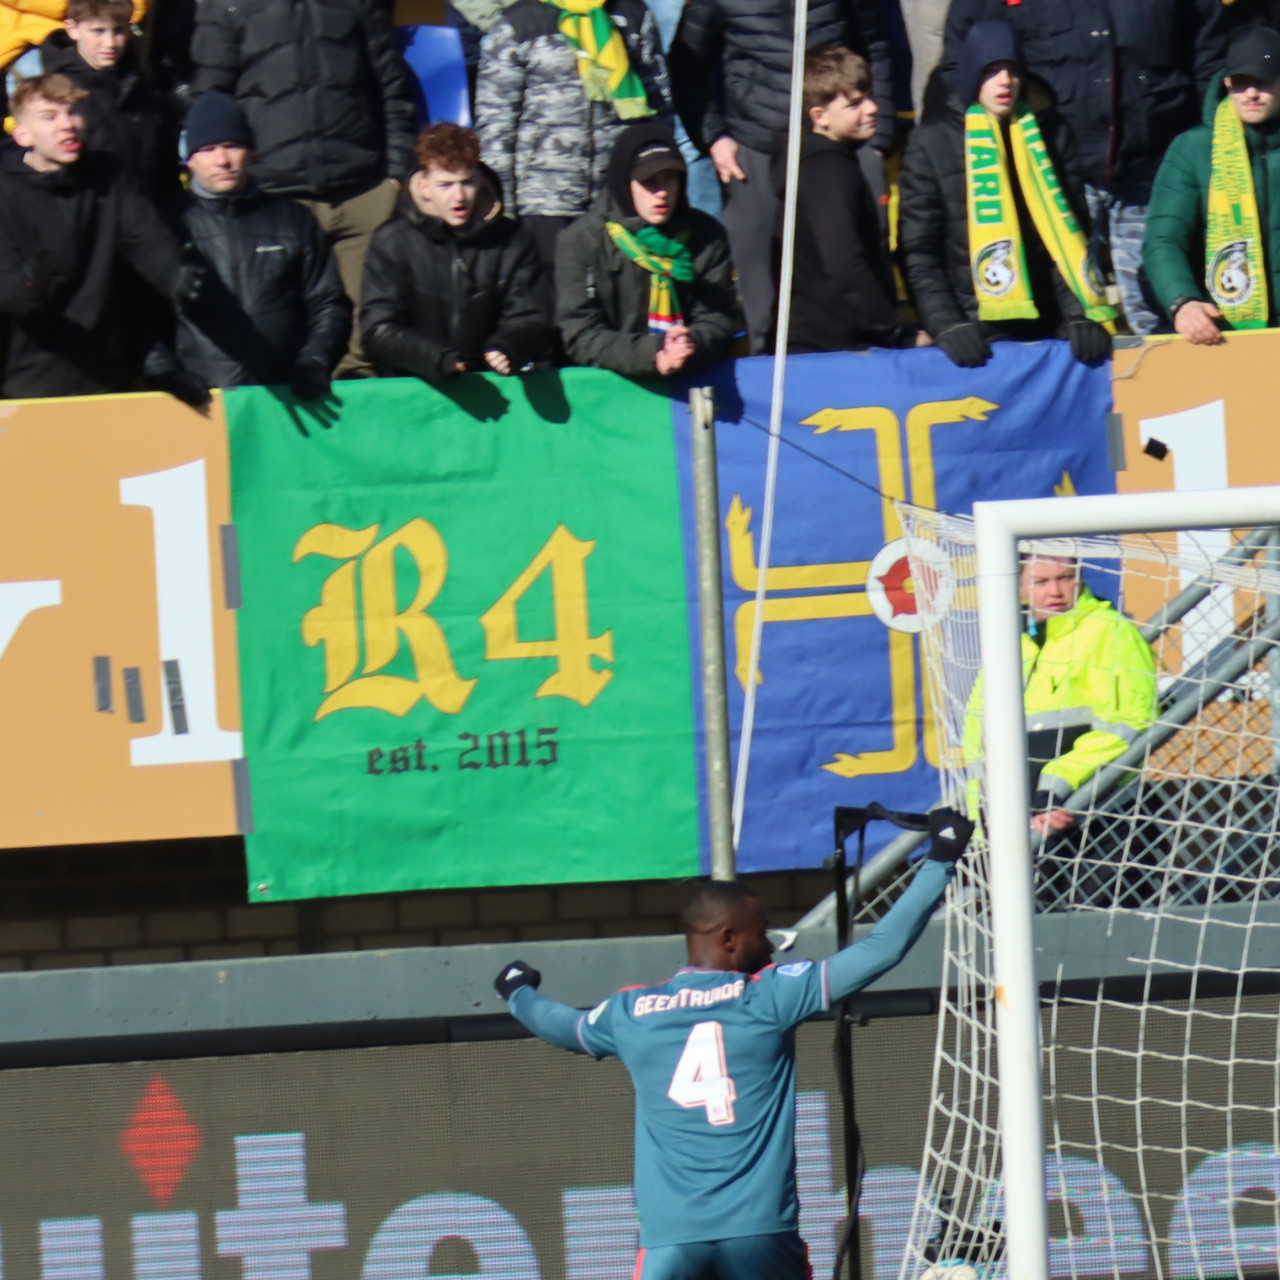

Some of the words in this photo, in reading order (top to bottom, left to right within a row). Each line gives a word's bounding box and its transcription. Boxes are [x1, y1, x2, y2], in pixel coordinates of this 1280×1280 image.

[119, 459, 243, 766] 1
[291, 516, 615, 723] R4
[366, 743, 440, 776] est.
[457, 727, 560, 771] 2015
[667, 1020, 738, 1127] 4
